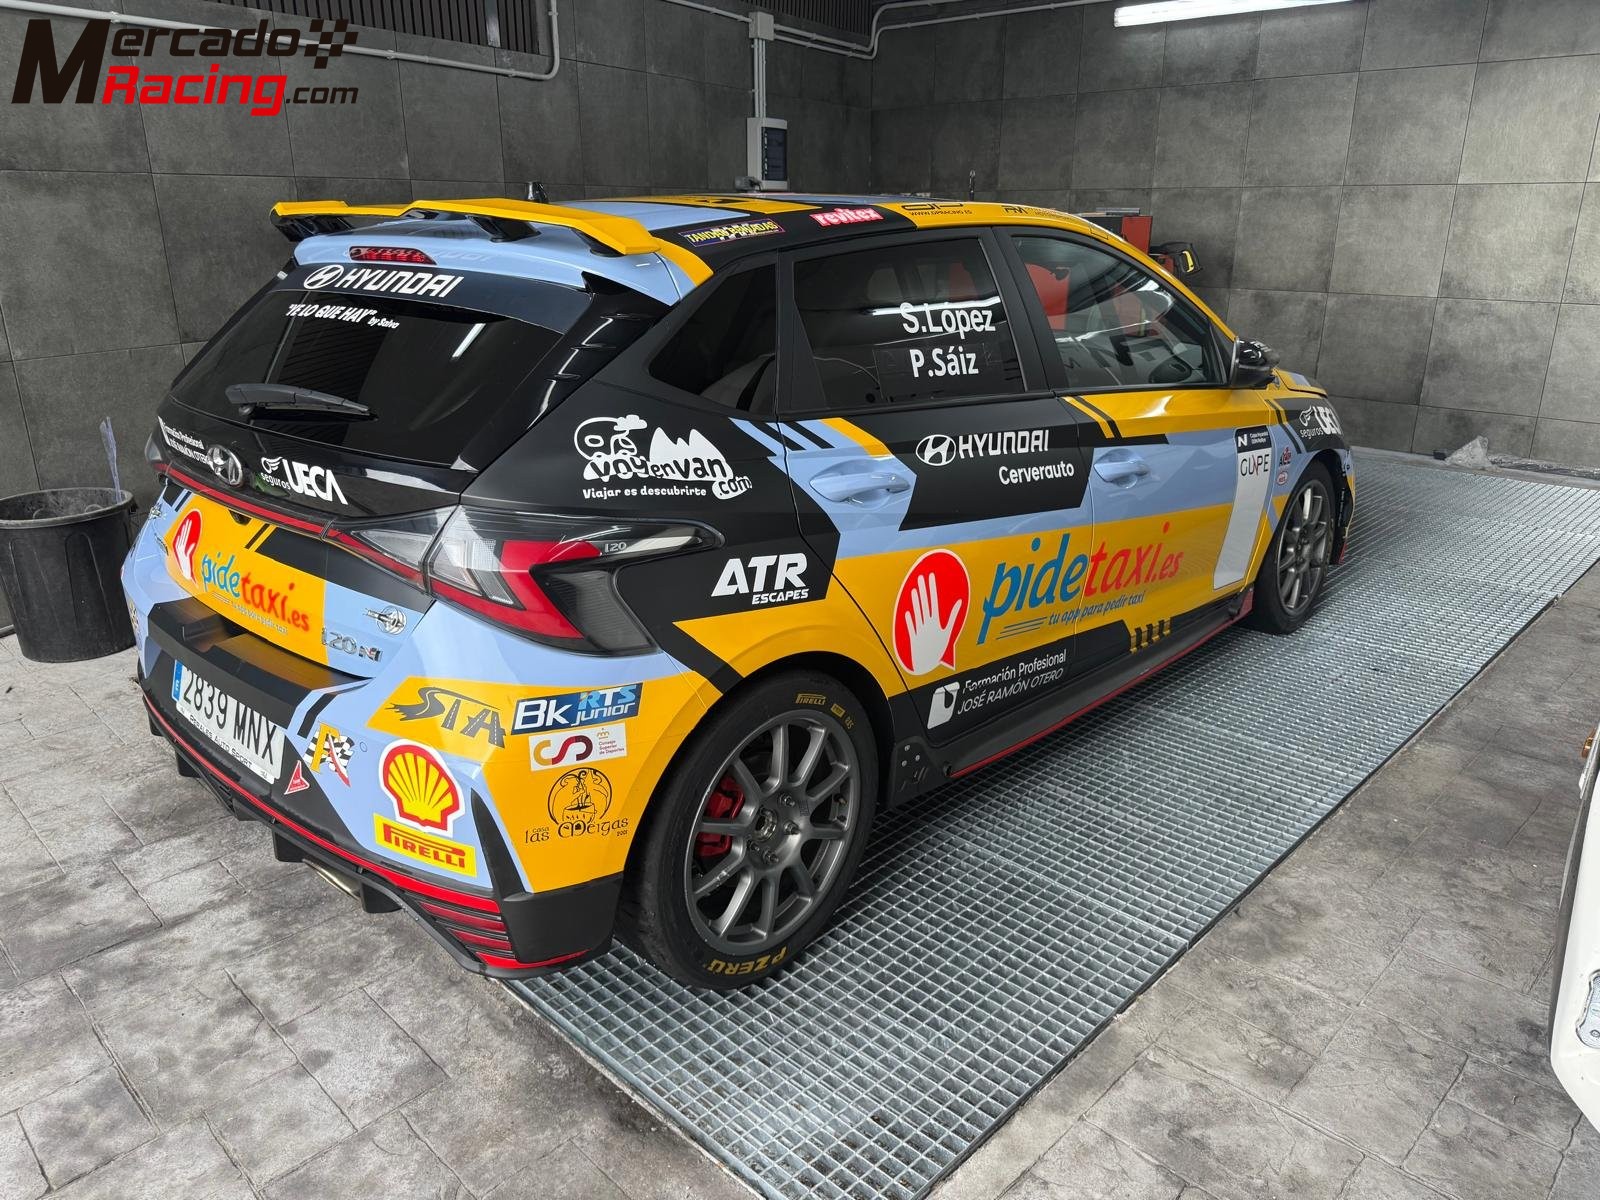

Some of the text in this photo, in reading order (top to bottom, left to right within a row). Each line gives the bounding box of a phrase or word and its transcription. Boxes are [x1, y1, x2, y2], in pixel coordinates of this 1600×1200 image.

[334, 268, 464, 298] HYUNDAI
[909, 346, 979, 378] P.Sáiz
[958, 429, 1050, 459] HYUNDAI
[260, 471, 291, 491] seguros
[999, 460, 1075, 485] Cerverauto
[582, 485, 707, 500] Viajar es descubrirte
[711, 552, 808, 597] ATR
[752, 588, 810, 605] ESCAPES
[963, 649, 1067, 693] Formación Profesional
[578, 684, 637, 711] RTS
[957, 667, 1064, 715] JOSÉ RAMÓN OTERO
[183, 666, 278, 766] 2839 MNX
[514, 699, 573, 730] Bk
[382, 823, 466, 869] PIRELLI
